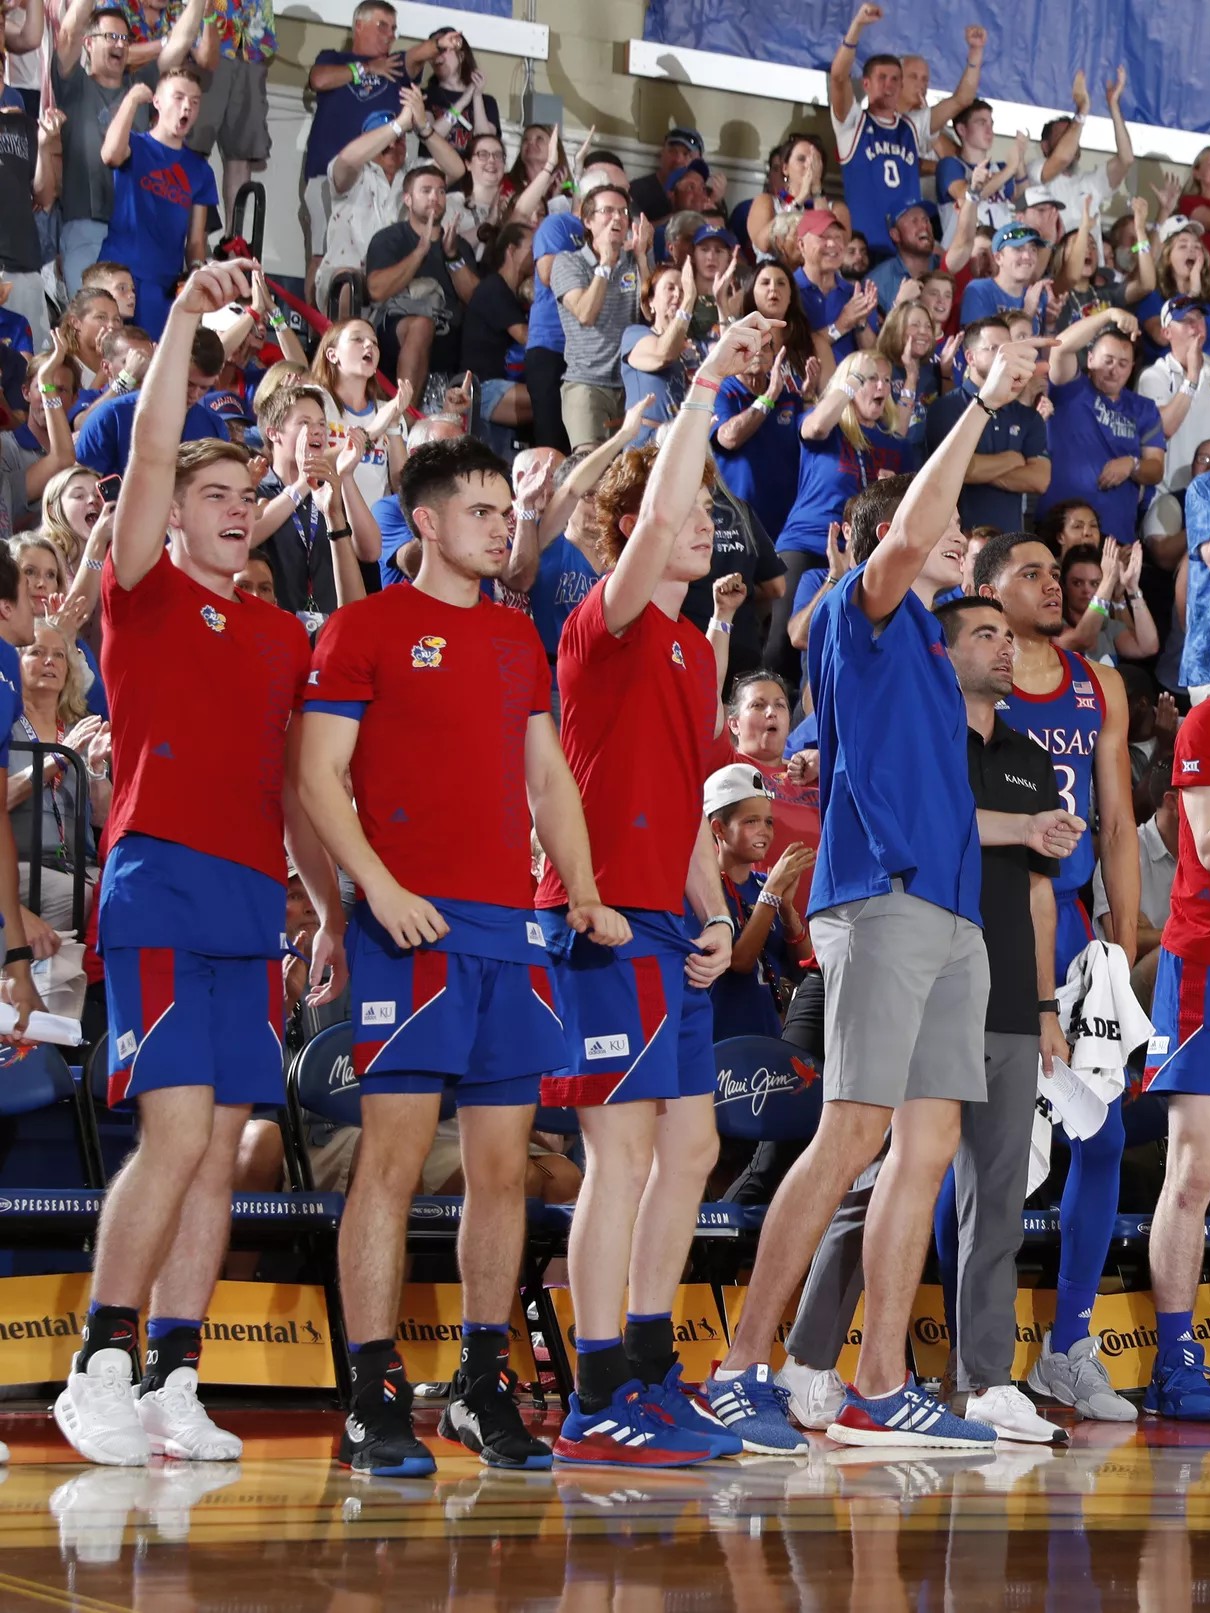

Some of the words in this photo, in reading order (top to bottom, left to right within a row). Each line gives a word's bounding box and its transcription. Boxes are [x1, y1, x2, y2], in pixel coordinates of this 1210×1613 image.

[884, 159, 901, 188] 0
[1027, 729, 1098, 755] NSAS
[609, 1040, 625, 1052] KU
[236, 1203, 324, 1215] SPECSEATS.COM
